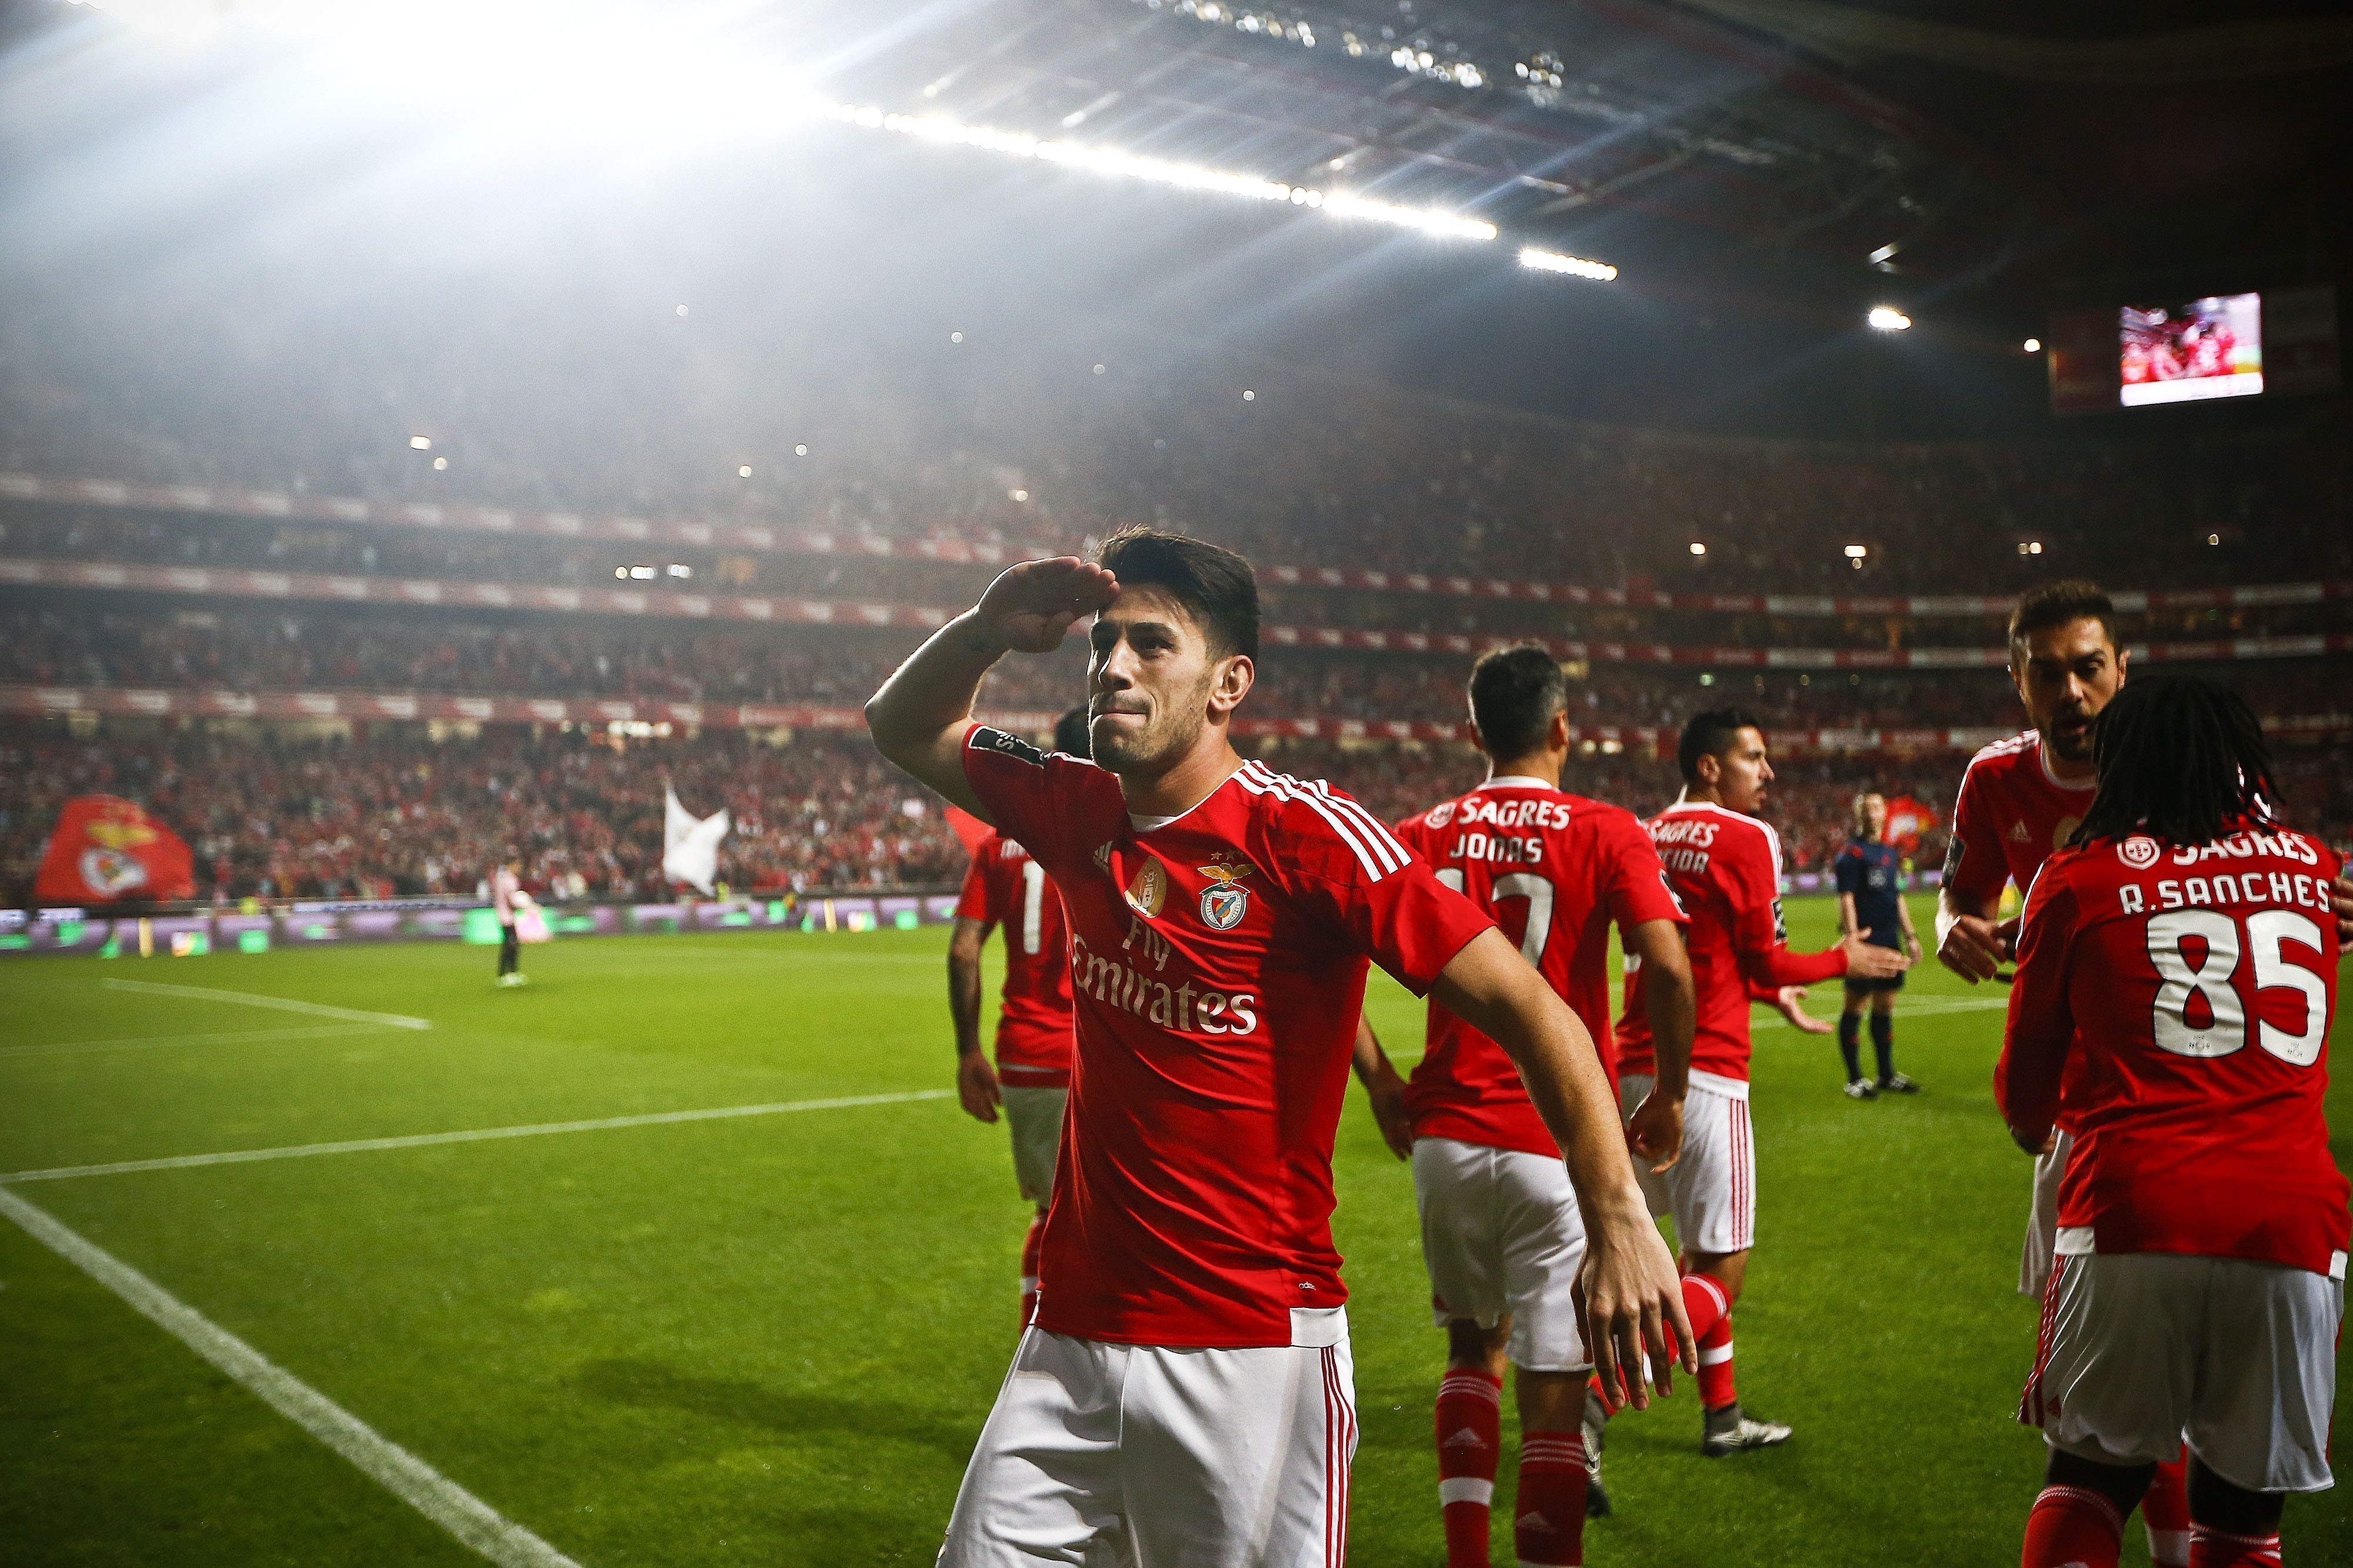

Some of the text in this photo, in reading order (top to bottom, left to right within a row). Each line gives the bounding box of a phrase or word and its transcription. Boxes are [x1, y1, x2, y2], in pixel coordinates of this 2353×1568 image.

[1458, 796, 1571, 830] SAGRES
[1649, 819, 1721, 848] SAGRES
[1449, 833, 1544, 864] JONAS
[2118, 871, 2330, 915] R.SANCHES
[1122, 914, 1171, 971] Fly
[1072, 933, 1257, 1035] Emirates
[2147, 909, 2327, 1067] 85
